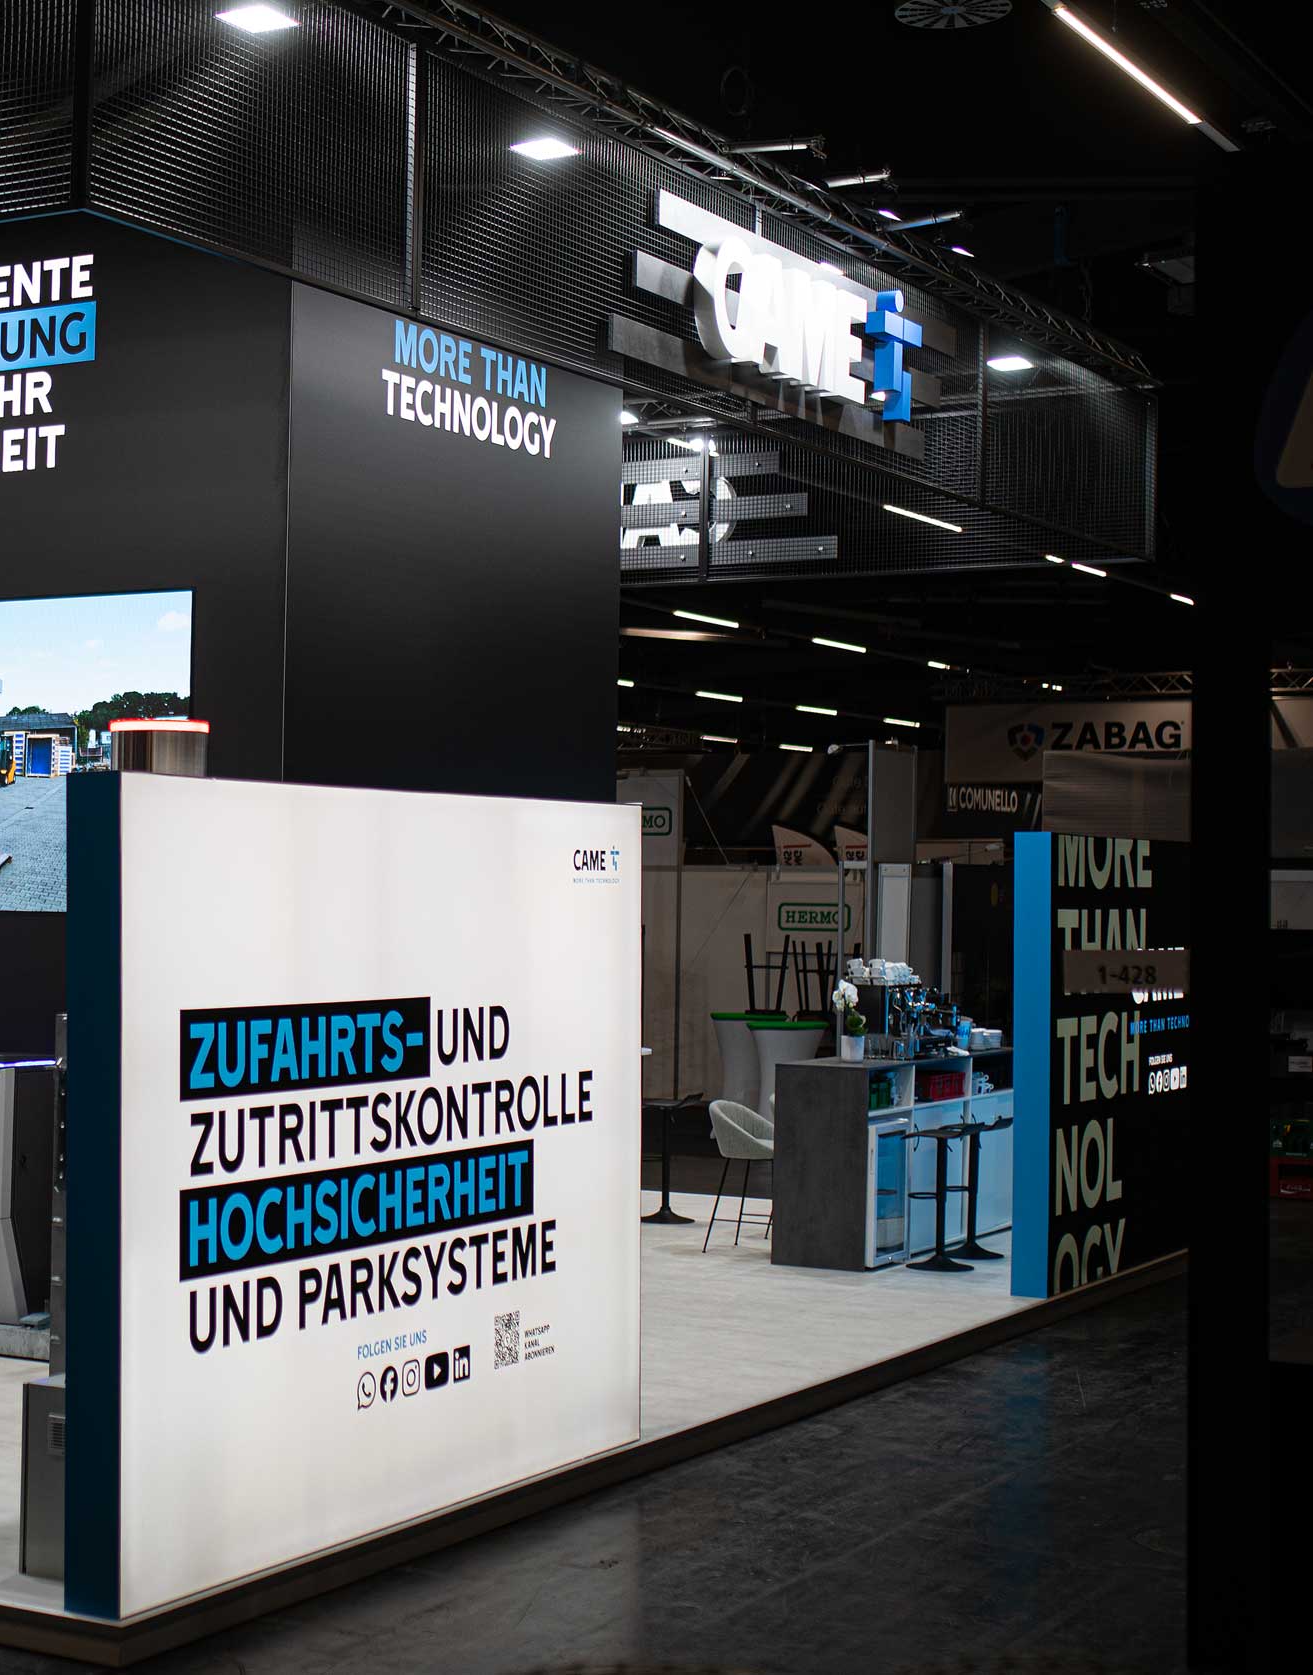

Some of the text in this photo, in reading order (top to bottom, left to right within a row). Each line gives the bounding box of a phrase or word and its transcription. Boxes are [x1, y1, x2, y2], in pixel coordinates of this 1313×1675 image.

[693, 235, 868, 405] CAME
[394, 319, 547, 408] MORE THAN
[381, 368, 557, 459] TECHNOLOGY
[1051, 720, 1183, 750] ZABAG
[958, 787, 1018, 813] COMUNELLO
[573, 849, 606, 871] CAME
[1057, 834, 1153, 890] MORE
[1097, 964, 1157, 985] 1-428
[189, 1005, 510, 1090] ZUFAHRTS- UND
[1057, 1010, 1141, 1105] TECH
[1149, 1017, 1166, 1033] THAN
[190, 1070, 594, 1178] ZUTRITTSKONTROLLE
[1056, 1117, 1123, 1217] NOL
[188, 1149, 529, 1268] HOCHSICHERHEIT
[189, 1219, 557, 1354] UND PARKSYSTEME
[357, 1329, 428, 1361] FOLGEN SIE UNS
[524, 1324, 551, 1338] WHATSAPP
[524, 1339, 540, 1350] KANAL
